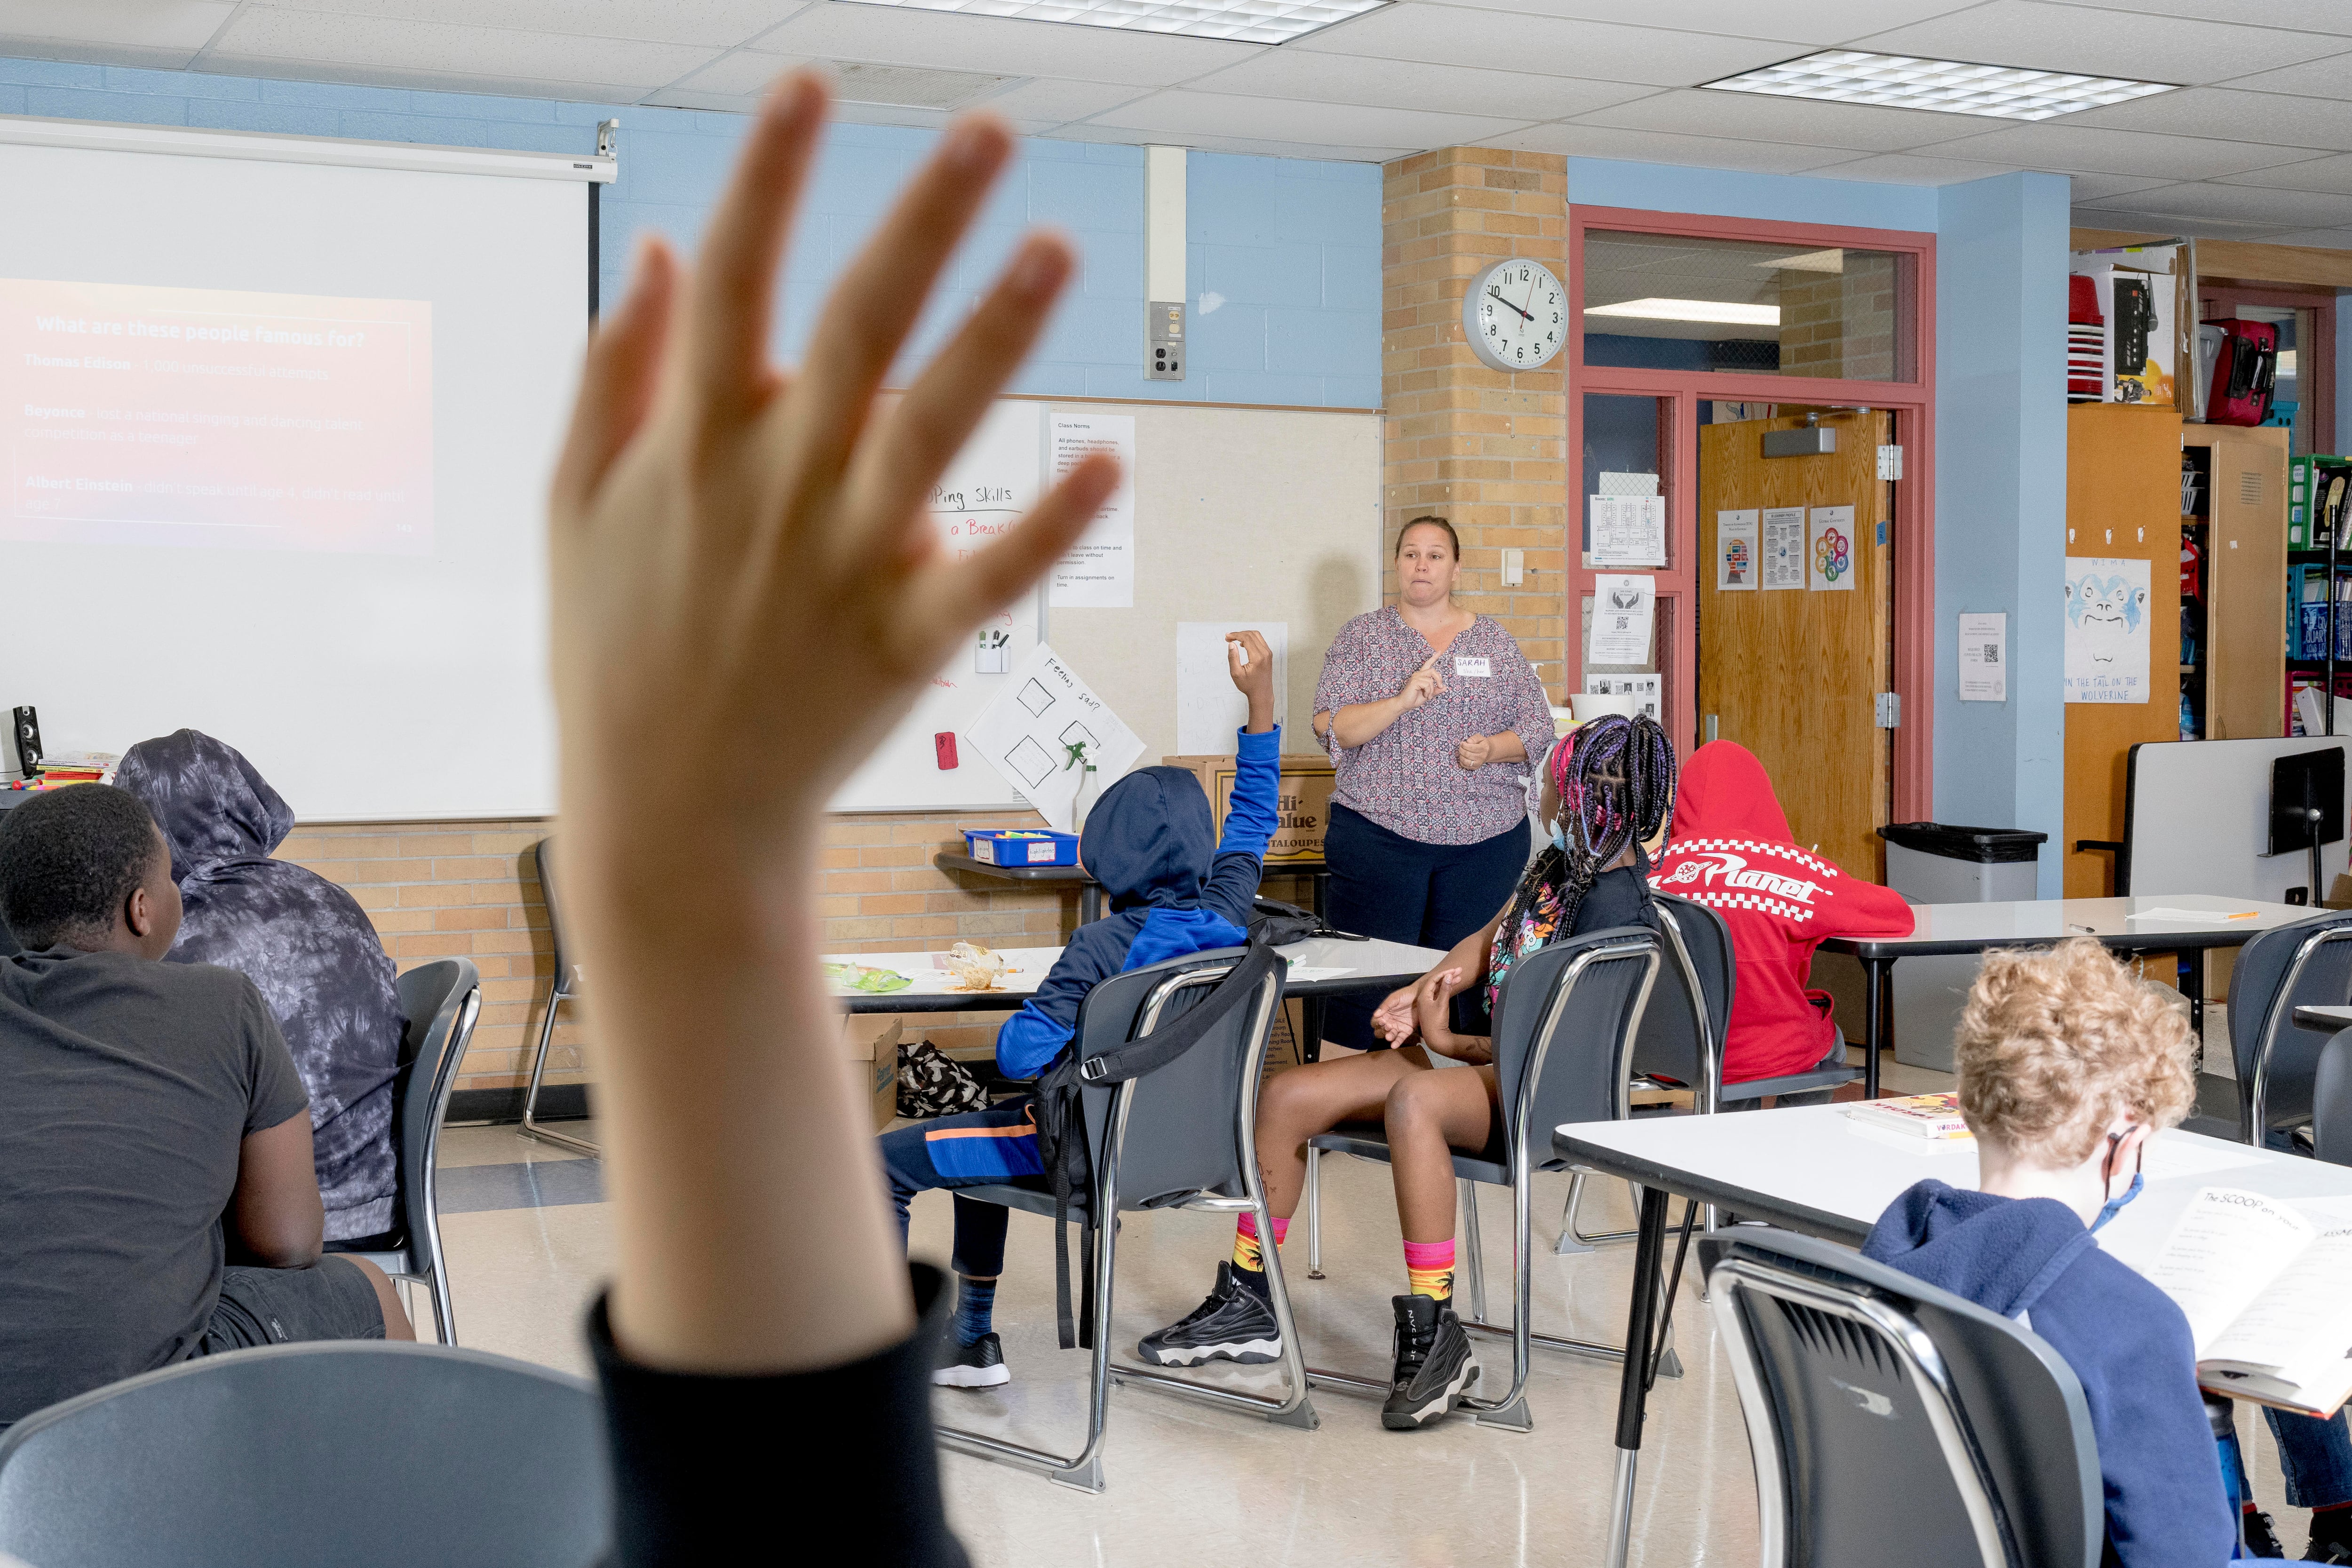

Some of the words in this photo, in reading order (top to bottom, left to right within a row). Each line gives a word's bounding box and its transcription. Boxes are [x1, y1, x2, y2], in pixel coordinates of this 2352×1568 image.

[1505, 272, 1512, 285] 11
[1520, 269, 1529, 281] 12
[1539, 277, 1542, 288] 1
[1491, 285, 1500, 298] 10
[1549, 292, 1555, 304] 2
[1486, 305, 1493, 316] 9
[1553, 312, 1558, 323] 3
[36, 316, 87, 334] What
[92, 322, 122, 335] are
[128, 320, 180, 339] these
[185, 324, 249, 343] people
[255, 326, 323, 346] famous
[328, 330, 365, 347] for?
[1490, 324, 1496, 336] 8
[1547, 331, 1553, 342] 4
[1502, 339, 1508, 351] 7
[1534, 343, 1540, 354] 5
[1517, 347, 1523, 358] 6
[23, 353, 79, 368] Thomas
[84, 356, 131, 370] Edison
[143, 359, 179, 374] 1,000
[183, 362, 266, 377] unsuccessful
[269, 366, 330, 381] attempts.
[24, 404, 86, 419] Beyonce
[97, 407, 121, 420] lost
[125, 411, 132, 420] a
[136, 410, 190, 423] national
[192, 412, 239, 427] singing
[244, 414, 266, 427] and
[271, 415, 321, 431] dancing
[325, 417, 363, 430] talent
[24, 427, 105, 441] competition
[139, 431, 198, 446] teenager
[25, 476, 72, 489] Albert
[76, 478, 132, 492] Einstein
[144, 481, 182, 493] didn't
[185, 483, 226, 496] speak
[228, 485, 256, 497] until
[261, 489, 283, 500] age
[286, 487, 298, 501] 4,
[302, 488, 339, 501] didn't
[343, 489, 371, 501] read
[376, 490, 404, 502] until
[976, 486, 1012, 503] Skills
[25, 501, 49, 512] age
[54, 499, 61, 510] 7
[966, 519, 1005, 535] Break
[2318, 616, 2328, 629] GIV
[2306, 630, 2327, 643] QUART
[1044, 658, 1073, 688] Feeling
[2077, 678, 2089, 687] THE
[2093, 678, 2109, 687] TAIL
[2112, 678, 2121, 686] ON
[2125, 677, 2137, 686] THE
[2082, 690, 2129, 700] WOLVERINE
[1278, 812, 1317, 828] alue
[1696, 852, 1816, 905] Planet
[2204, 1193, 2218, 1202] The
[2220, 1194, 2263, 1209] SCOOP
